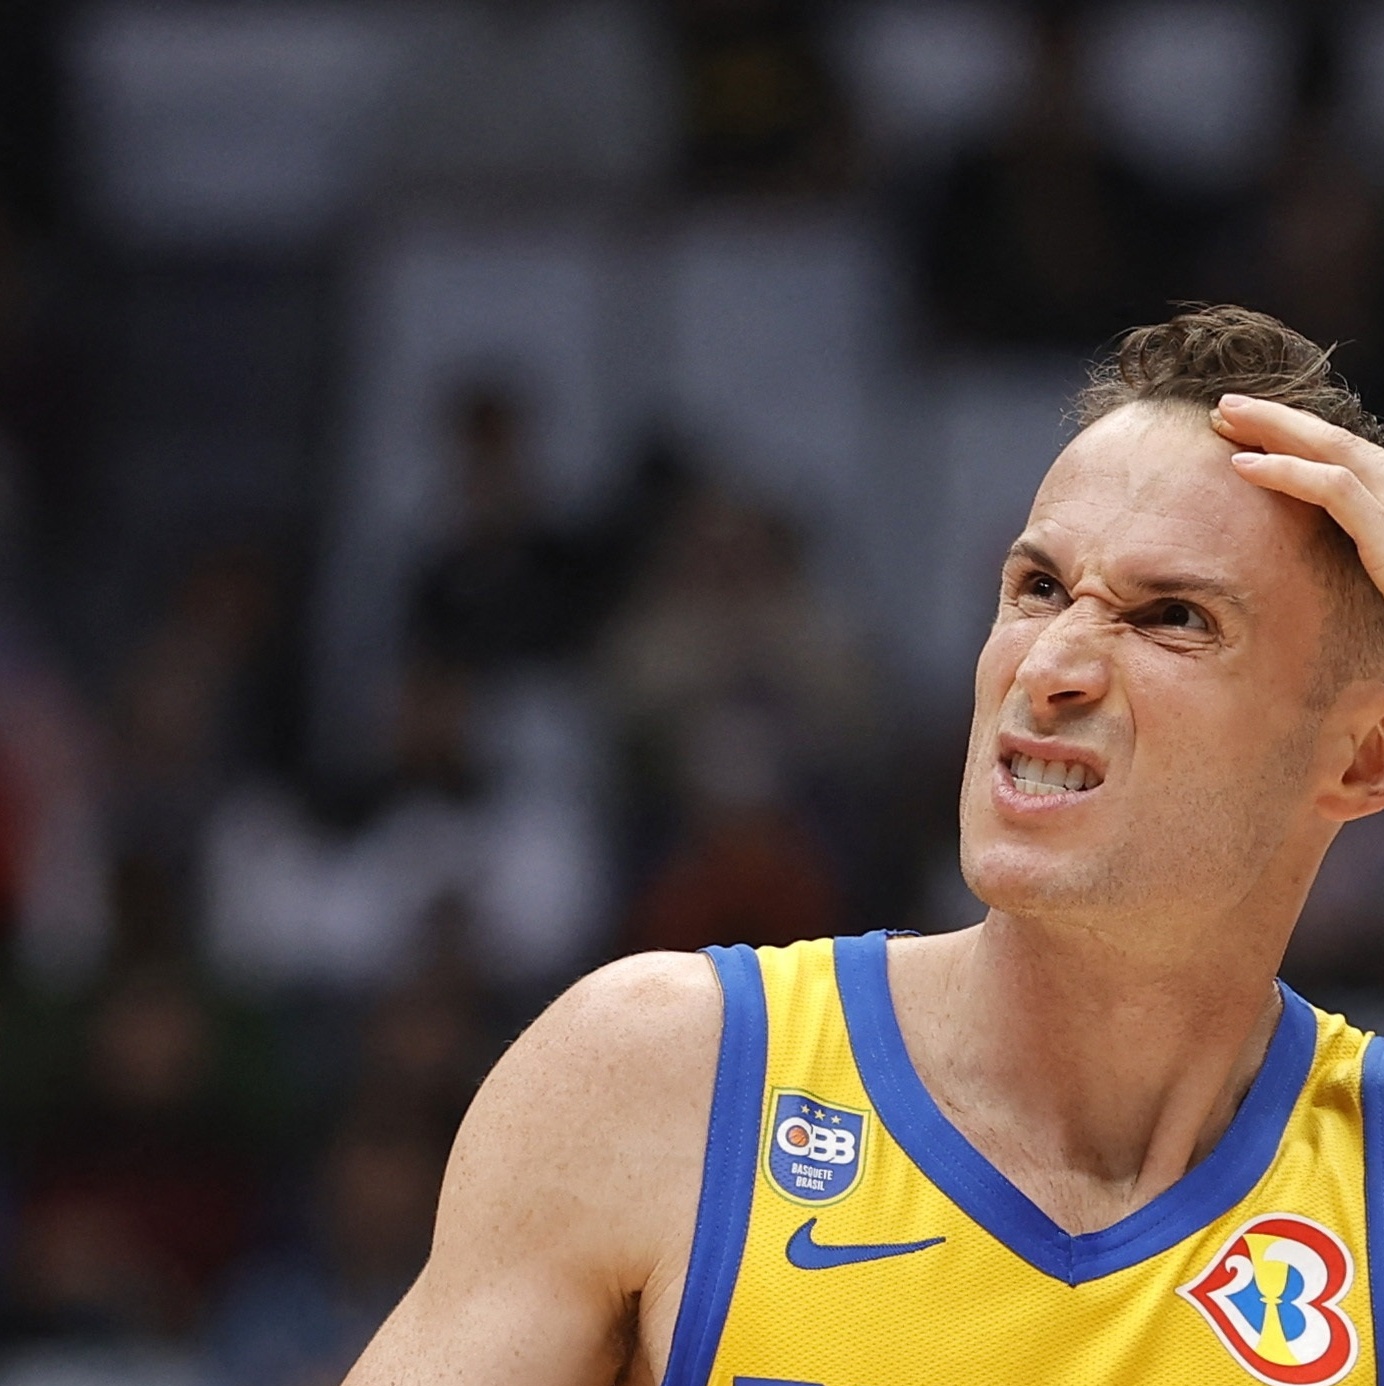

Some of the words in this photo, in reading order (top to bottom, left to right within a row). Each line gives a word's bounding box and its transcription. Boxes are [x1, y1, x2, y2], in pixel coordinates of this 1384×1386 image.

[777, 1117, 855, 1164] CBB
[791, 1163, 833, 1180] BASQUETE
[796, 1176, 825, 1191] BRASIL
